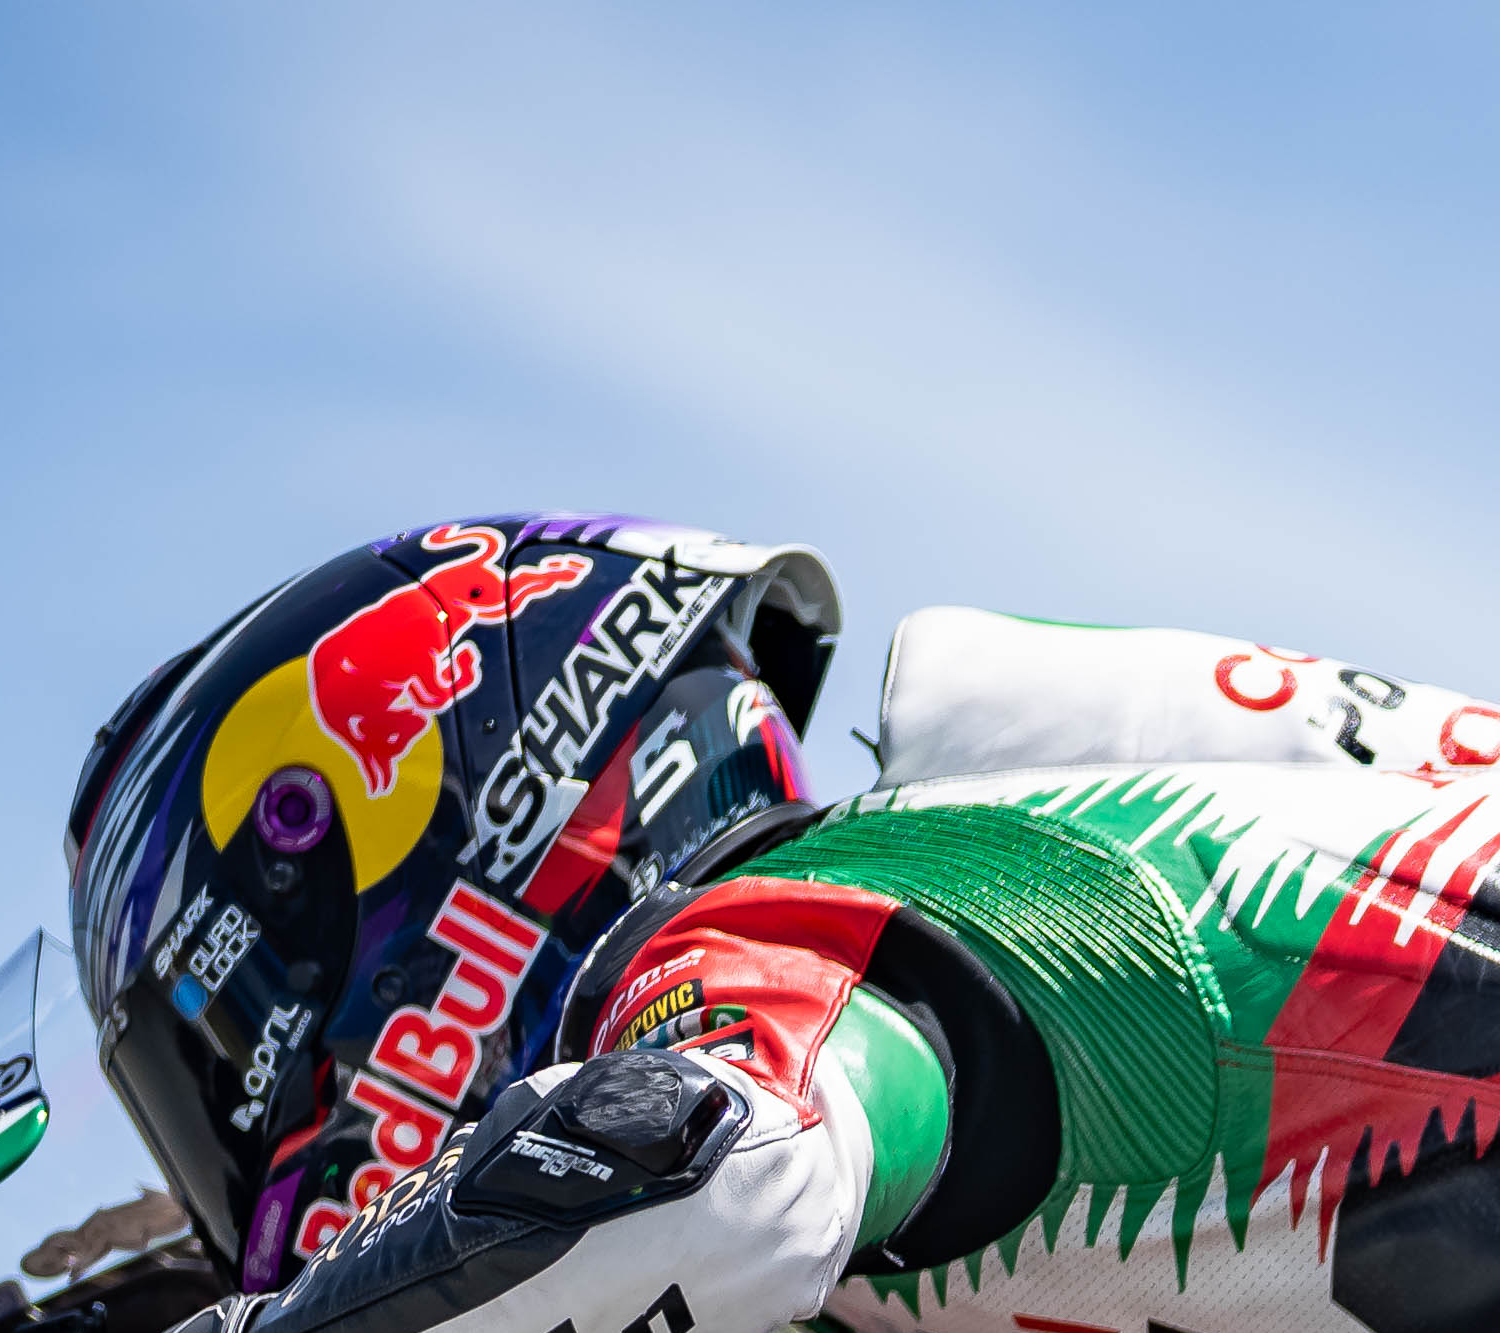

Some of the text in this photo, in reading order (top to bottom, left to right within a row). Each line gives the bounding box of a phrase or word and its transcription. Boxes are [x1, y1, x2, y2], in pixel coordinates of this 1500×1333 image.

[652, 574, 728, 666] HELMETS
[478, 545, 708, 855] SHARK
[155, 883, 214, 978] SHARK
[189, 904, 243, 976] QUAD
[203, 917, 258, 991] LOCK
